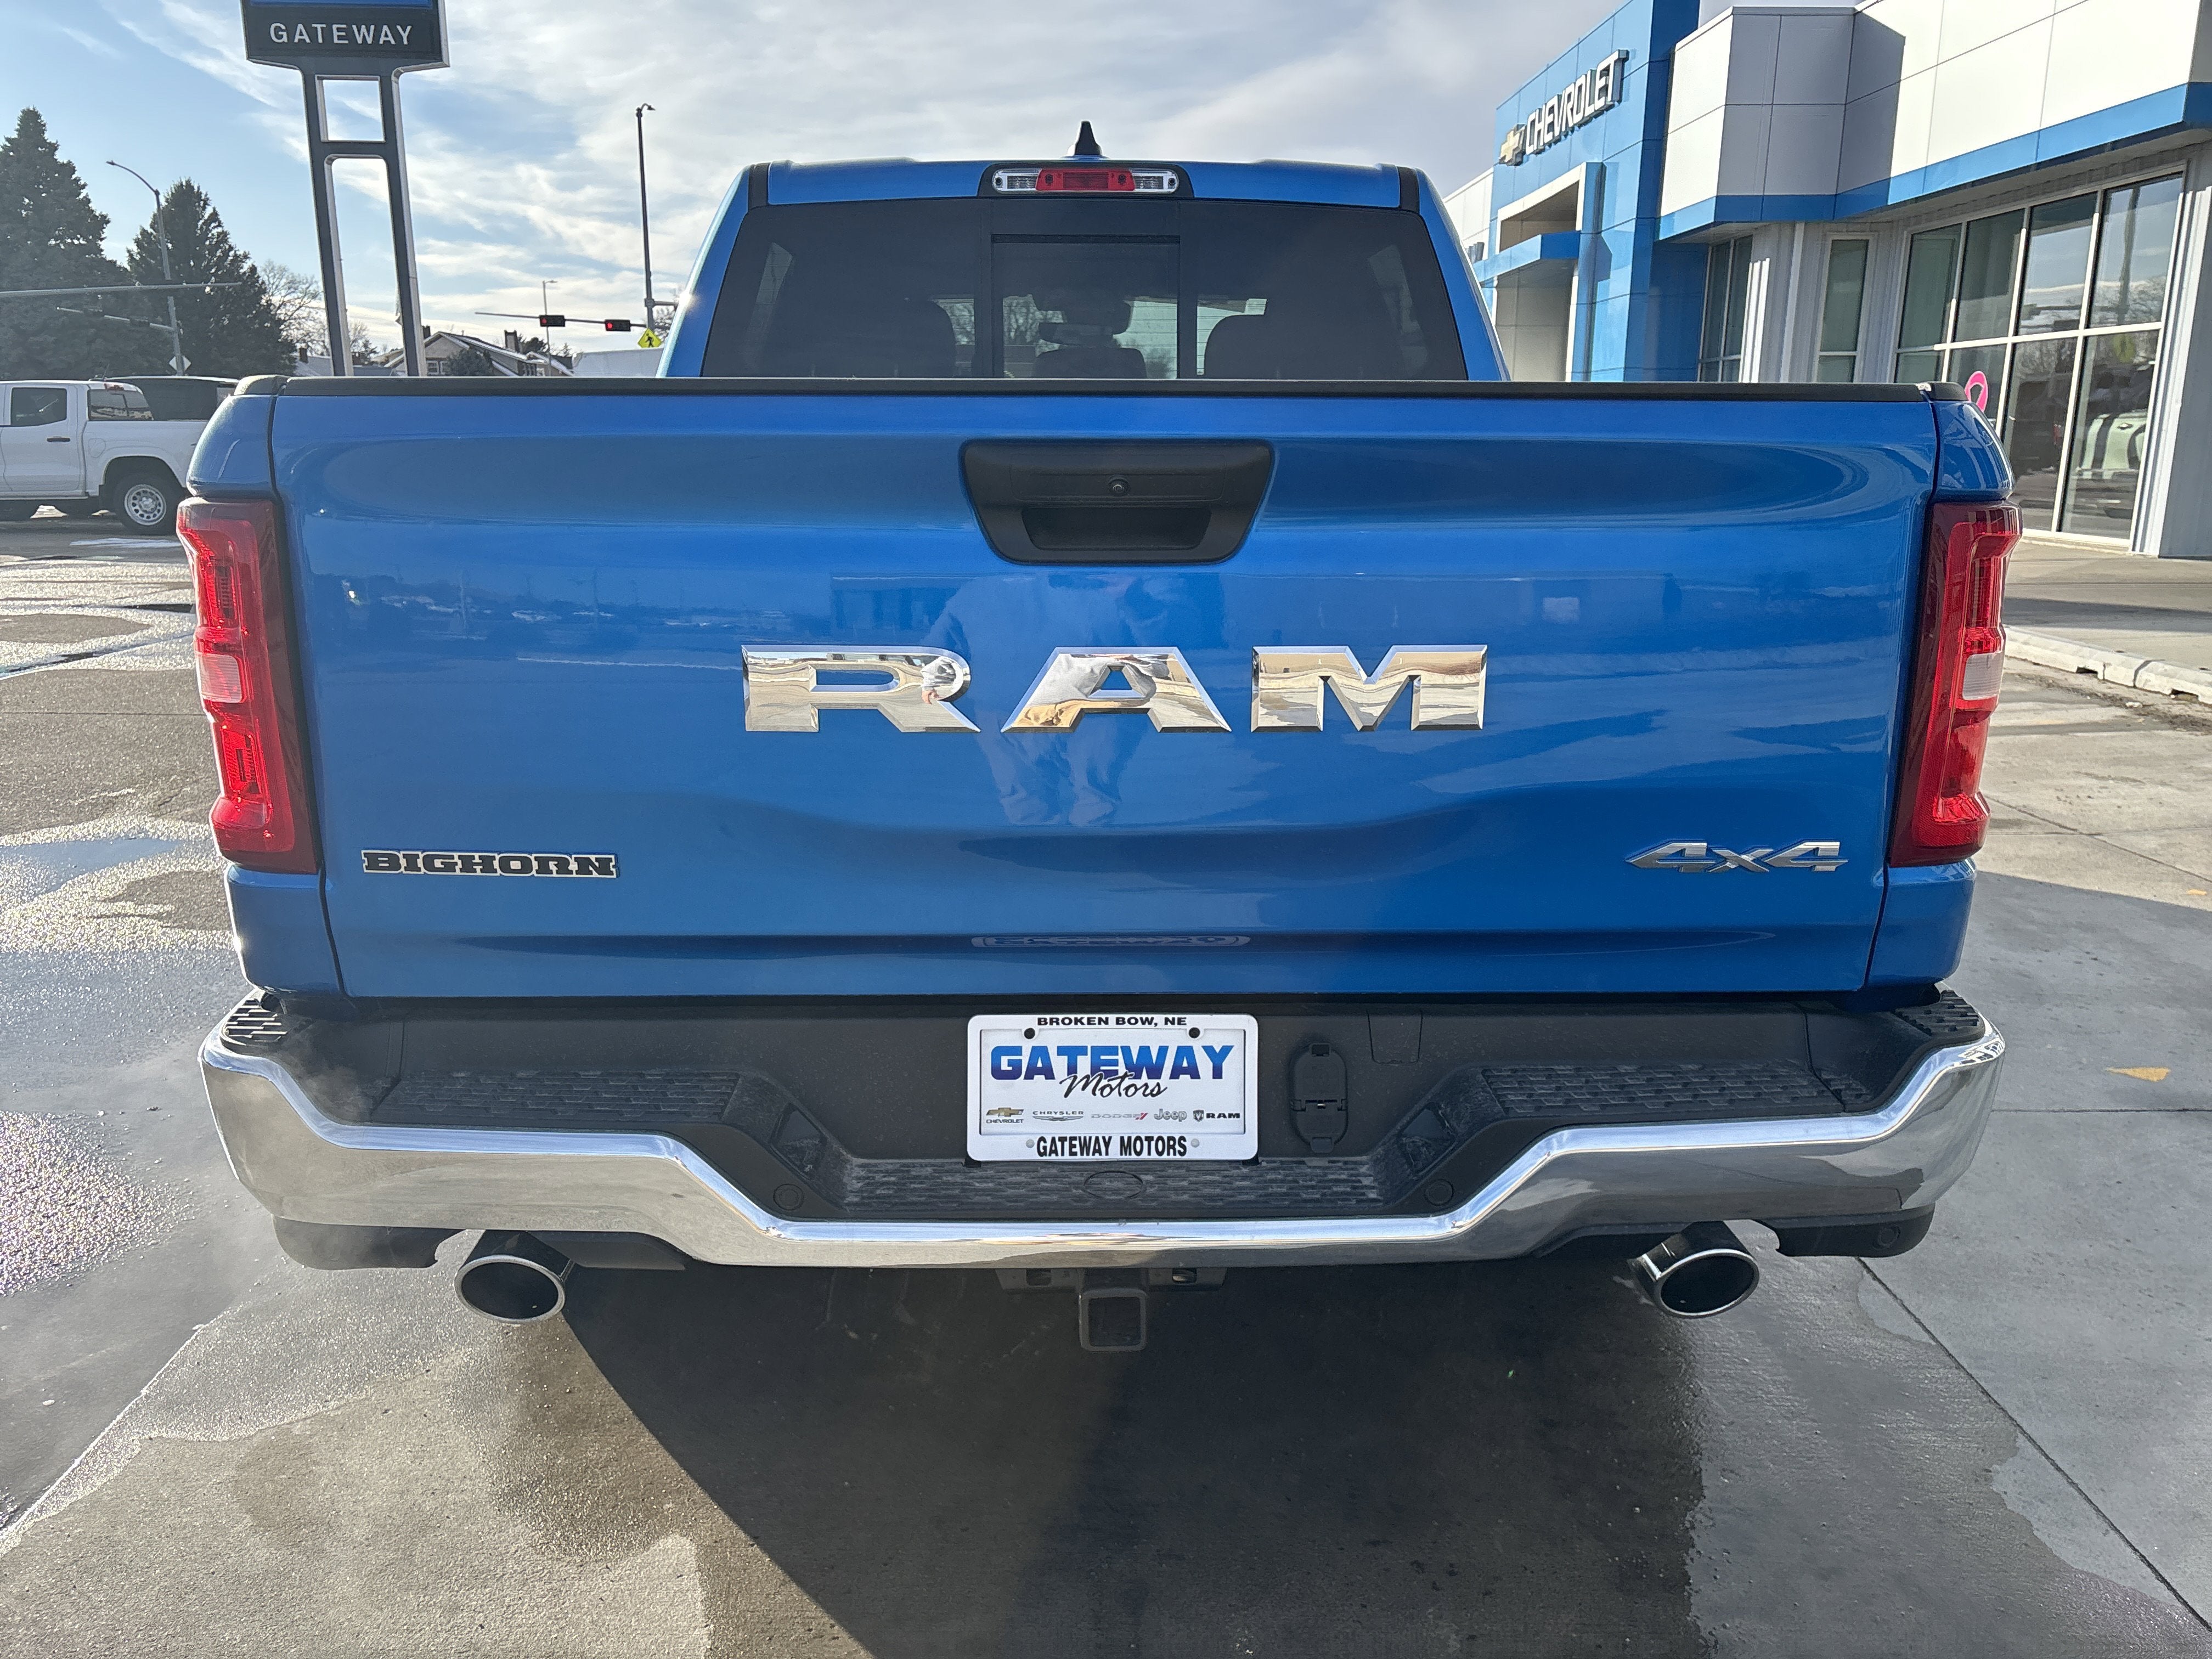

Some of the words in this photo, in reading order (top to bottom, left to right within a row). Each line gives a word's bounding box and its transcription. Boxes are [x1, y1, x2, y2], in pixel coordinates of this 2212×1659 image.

[269, 22, 412, 46] GATEWAY
[1525, 49, 1629, 155] CHEVROLET
[741, 644, 1488, 733] RAM
[361, 850, 617, 878] BIGHORN
[1037, 1017, 1109, 1026] BROKEN
[1115, 1017, 1158, 1027] BOW,
[1164, 1017, 1187, 1025] NE
[991, 1045, 1234, 1080] GATEWAY
[1059, 1071, 1167, 1098] Motors
[1154, 1108, 1187, 1122] Jeep
[1037, 1136, 1112, 1157] GATEWAY
[1120, 1135, 1187, 1156] MOTORS
